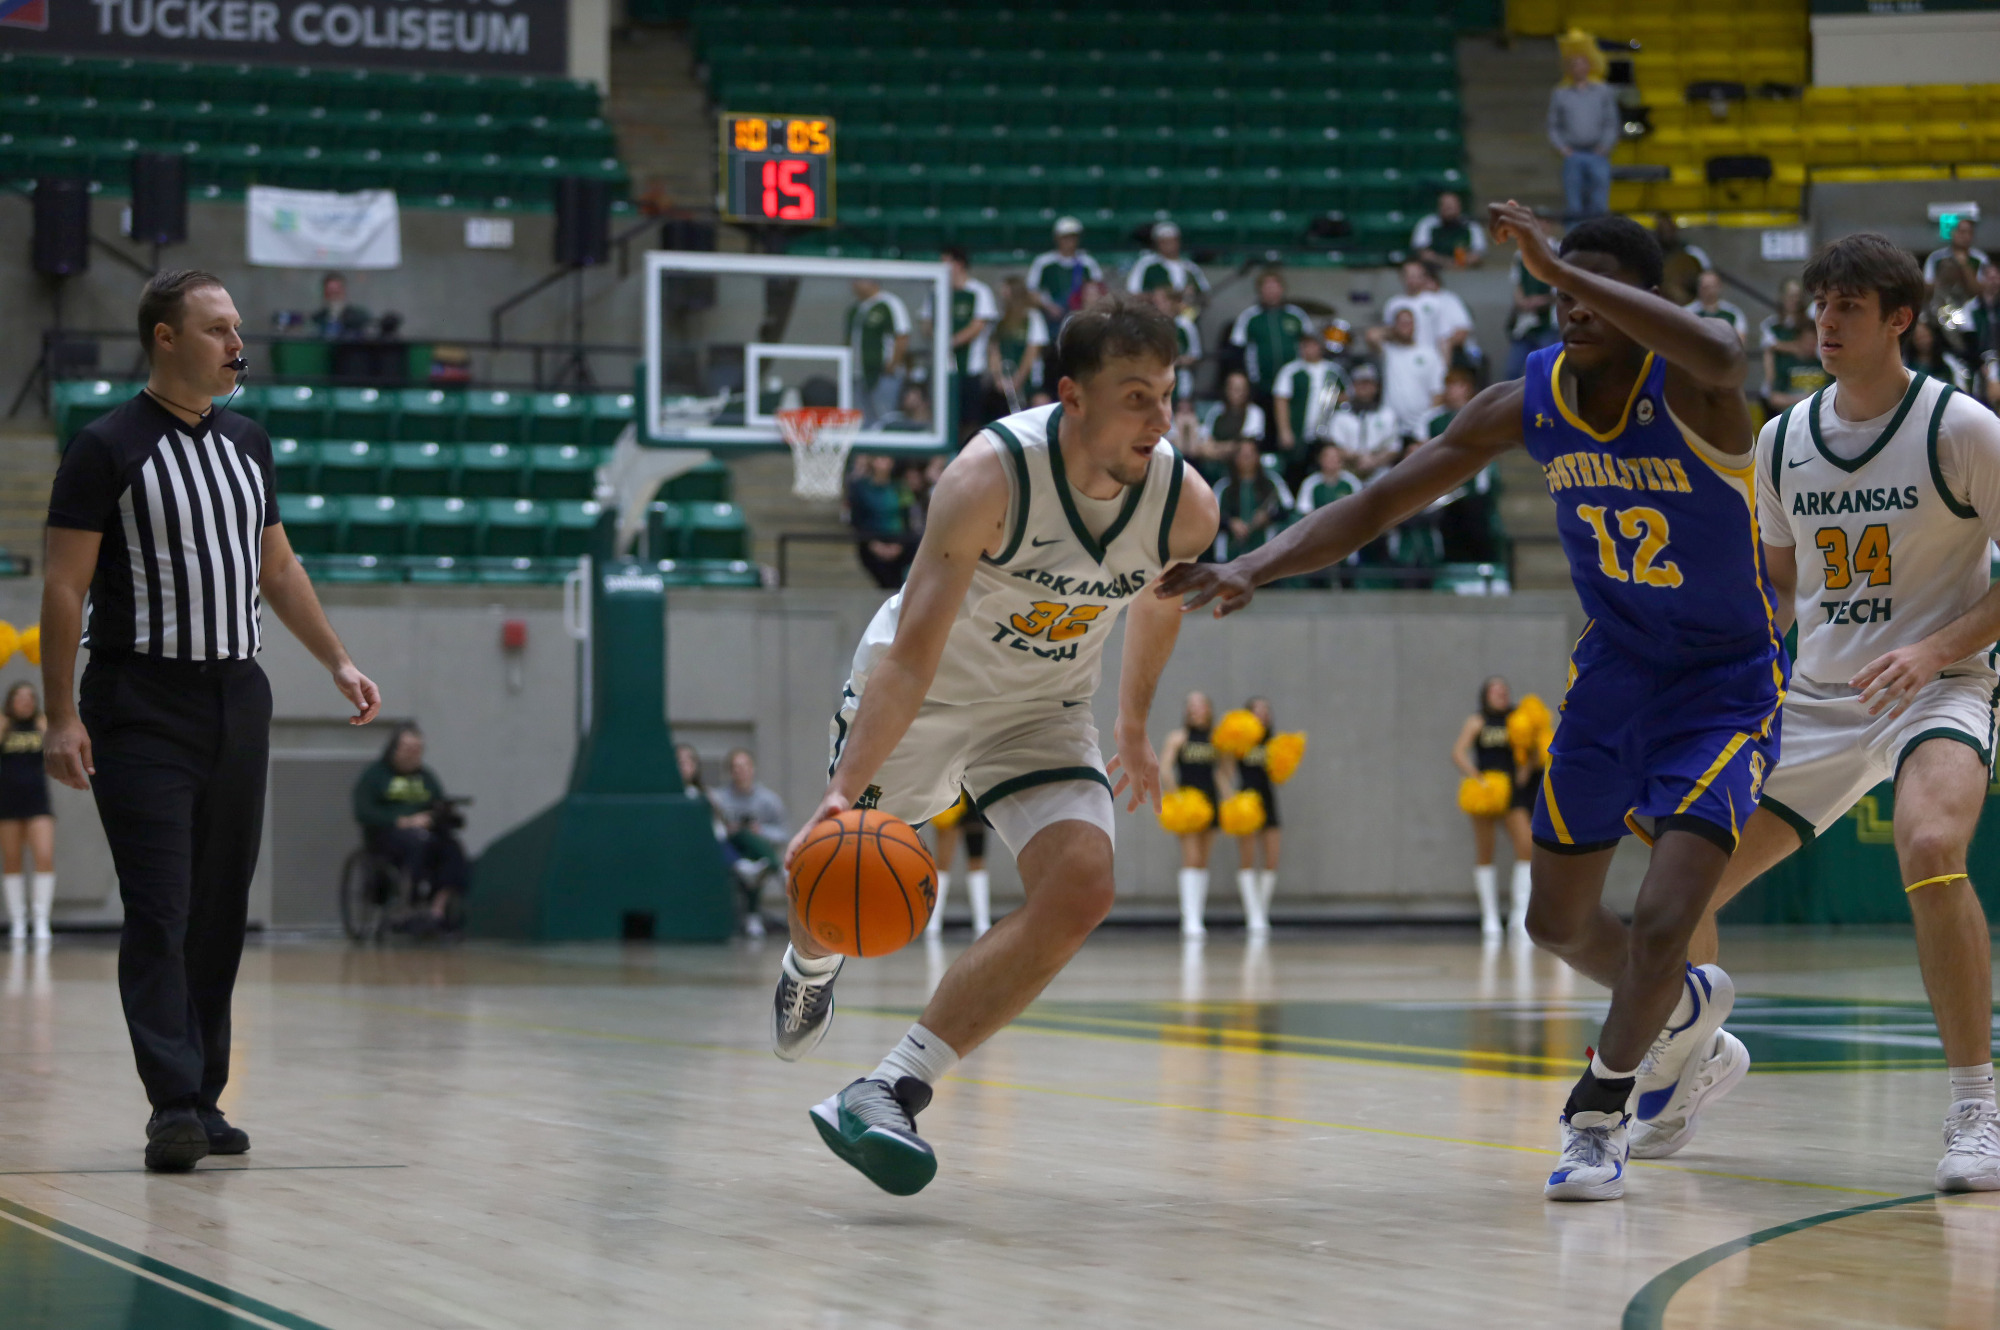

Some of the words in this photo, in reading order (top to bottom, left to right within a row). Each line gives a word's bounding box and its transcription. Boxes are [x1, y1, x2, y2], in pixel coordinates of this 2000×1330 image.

[93, 0, 280, 42] TUCKER
[291, 4, 530, 54] COLISEUM
[762, 159, 815, 220] 15
[1792, 486, 1919, 516] ARKANSAS
[1577, 504, 1684, 588] 12
[1815, 523, 1892, 590] 34
[1011, 569, 1146, 599] ARKANSAS
[1010, 601, 1108, 642] 32
[1820, 598, 1892, 625] TECH
[991, 621, 1079, 662] TECH
